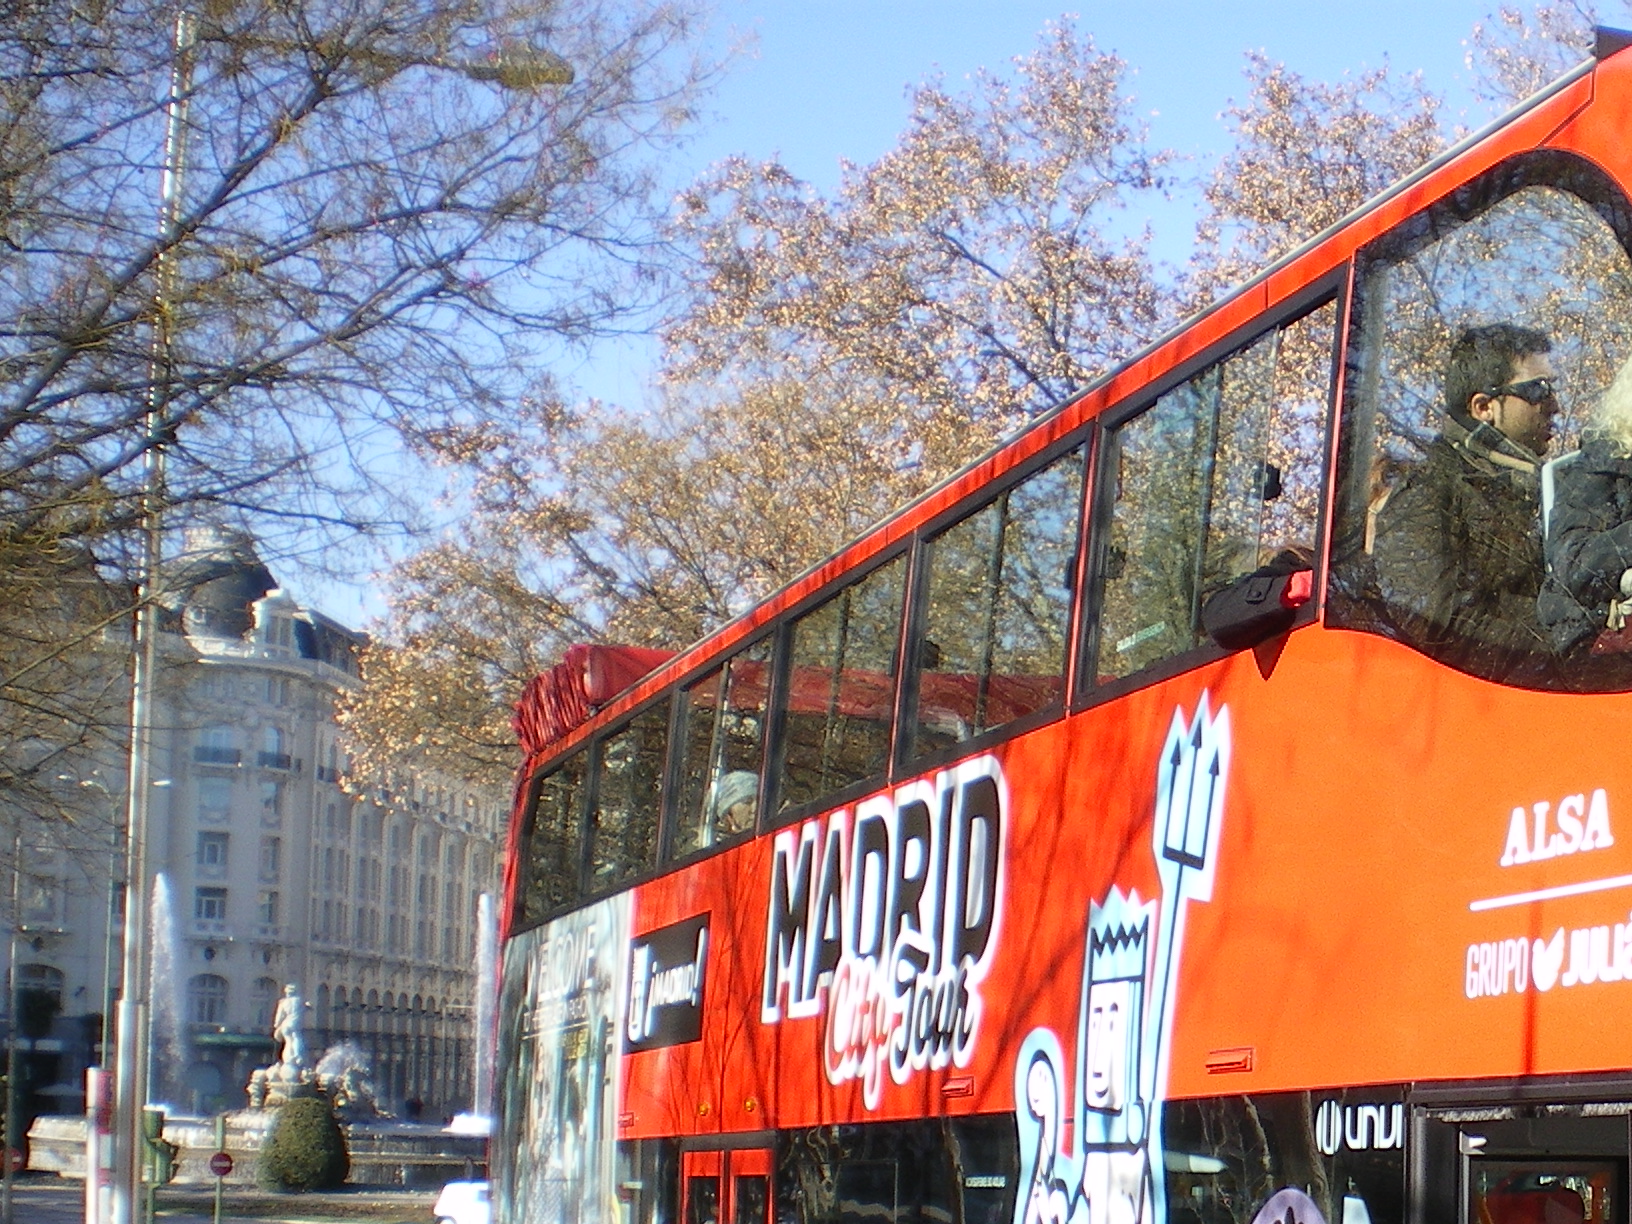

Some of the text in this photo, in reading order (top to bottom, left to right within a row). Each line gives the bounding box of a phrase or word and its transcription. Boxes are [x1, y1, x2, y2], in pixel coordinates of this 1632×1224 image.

[762, 755, 1008, 1023] MADRID
[1501, 788, 1614, 866] ALSA
[825, 934, 981, 1111] City Tour
[1466, 936, 1528, 998] GRUPO
